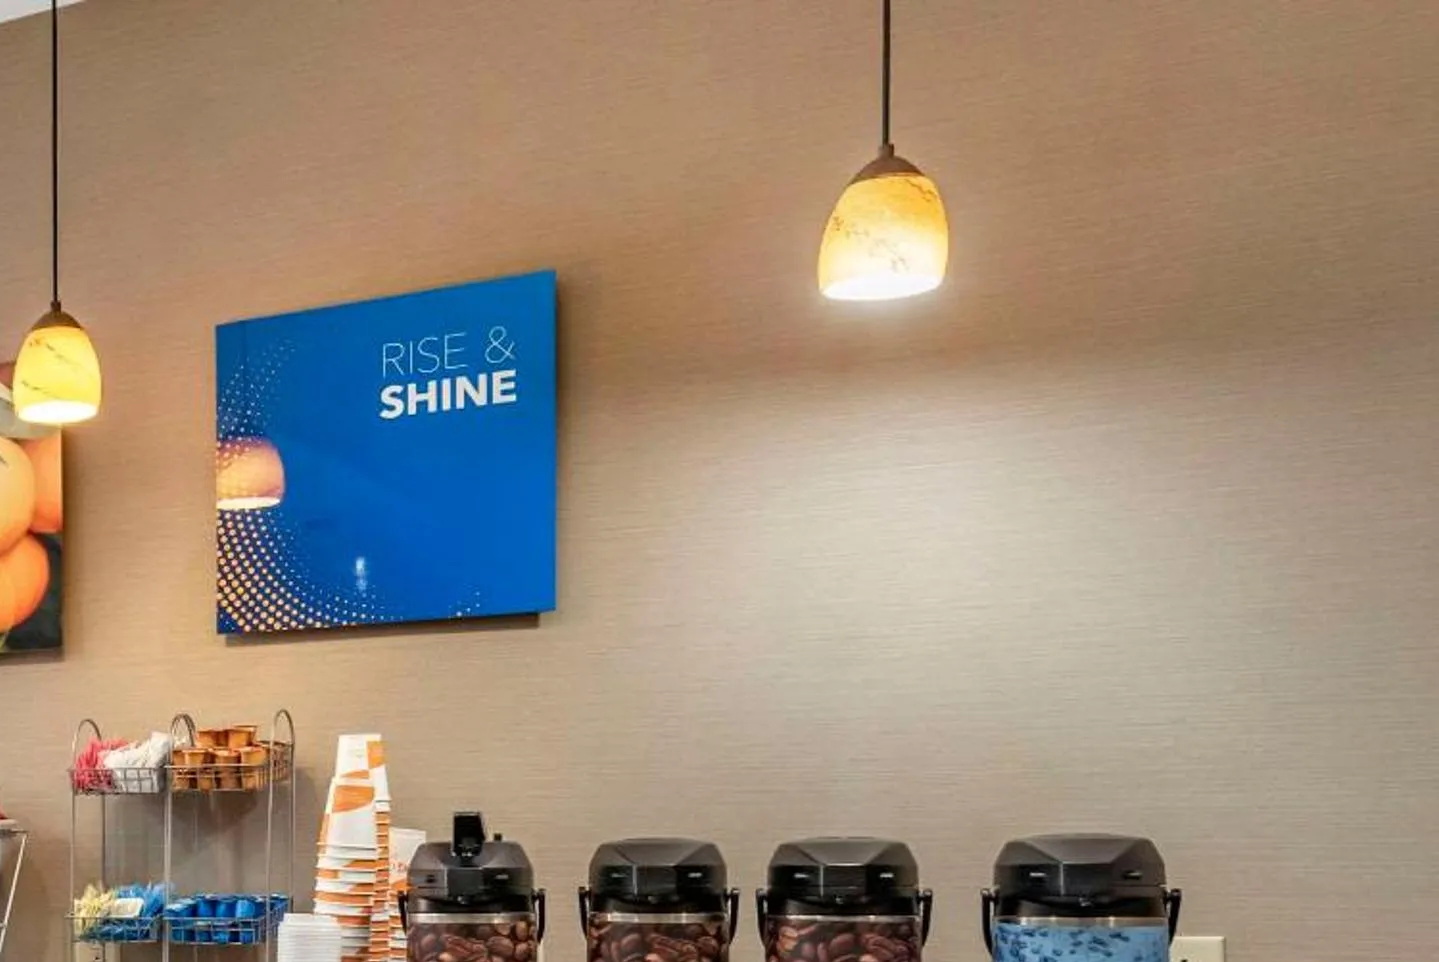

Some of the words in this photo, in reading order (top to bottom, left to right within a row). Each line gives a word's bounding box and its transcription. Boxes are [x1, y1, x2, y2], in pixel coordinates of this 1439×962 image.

[382, 332, 468, 379] RISE
[484, 325, 516, 364] &
[379, 369, 517, 419] SHINE
